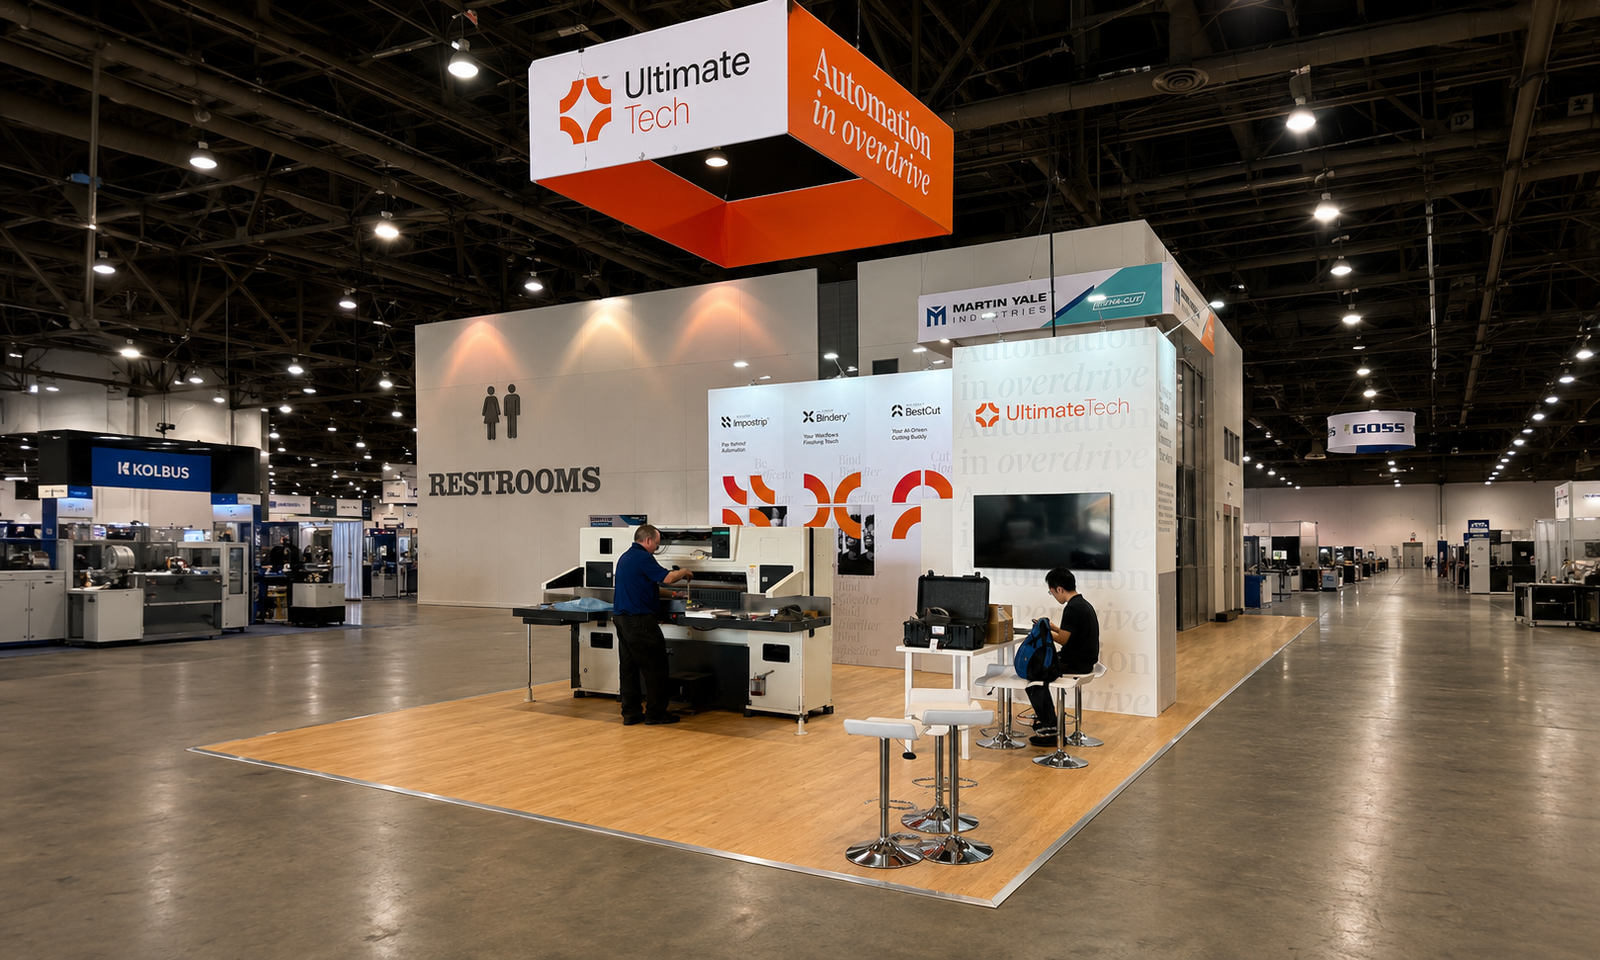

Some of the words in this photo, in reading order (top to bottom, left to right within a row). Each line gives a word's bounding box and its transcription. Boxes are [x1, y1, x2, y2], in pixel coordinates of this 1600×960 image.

[624, 50, 751, 99] Ultimate
[625, 97, 690, 135] Tech
[813, 47, 932, 161] Automation
[812, 90, 836, 136] in
[842, 118, 932, 196] overdrive
[953, 298, 1008, 315] MARTIN
[1012, 292, 1047, 306] YALE
[953, 305, 1047, 324] INDTRIES
[960, 374, 989, 401] in
[997, 361, 1149, 398] overdrive
[816, 413, 848, 422] Bindery
[905, 405, 941, 417] BestCut
[1006, 397, 1130, 421] UltimateTech
[1353, 423, 1405, 434] GOSS
[132, 463, 190, 479] KOLBUS
[960, 449, 989, 476] in
[997, 440, 1149, 475] overdrive
[428, 466, 601, 496] RESTROOMS
